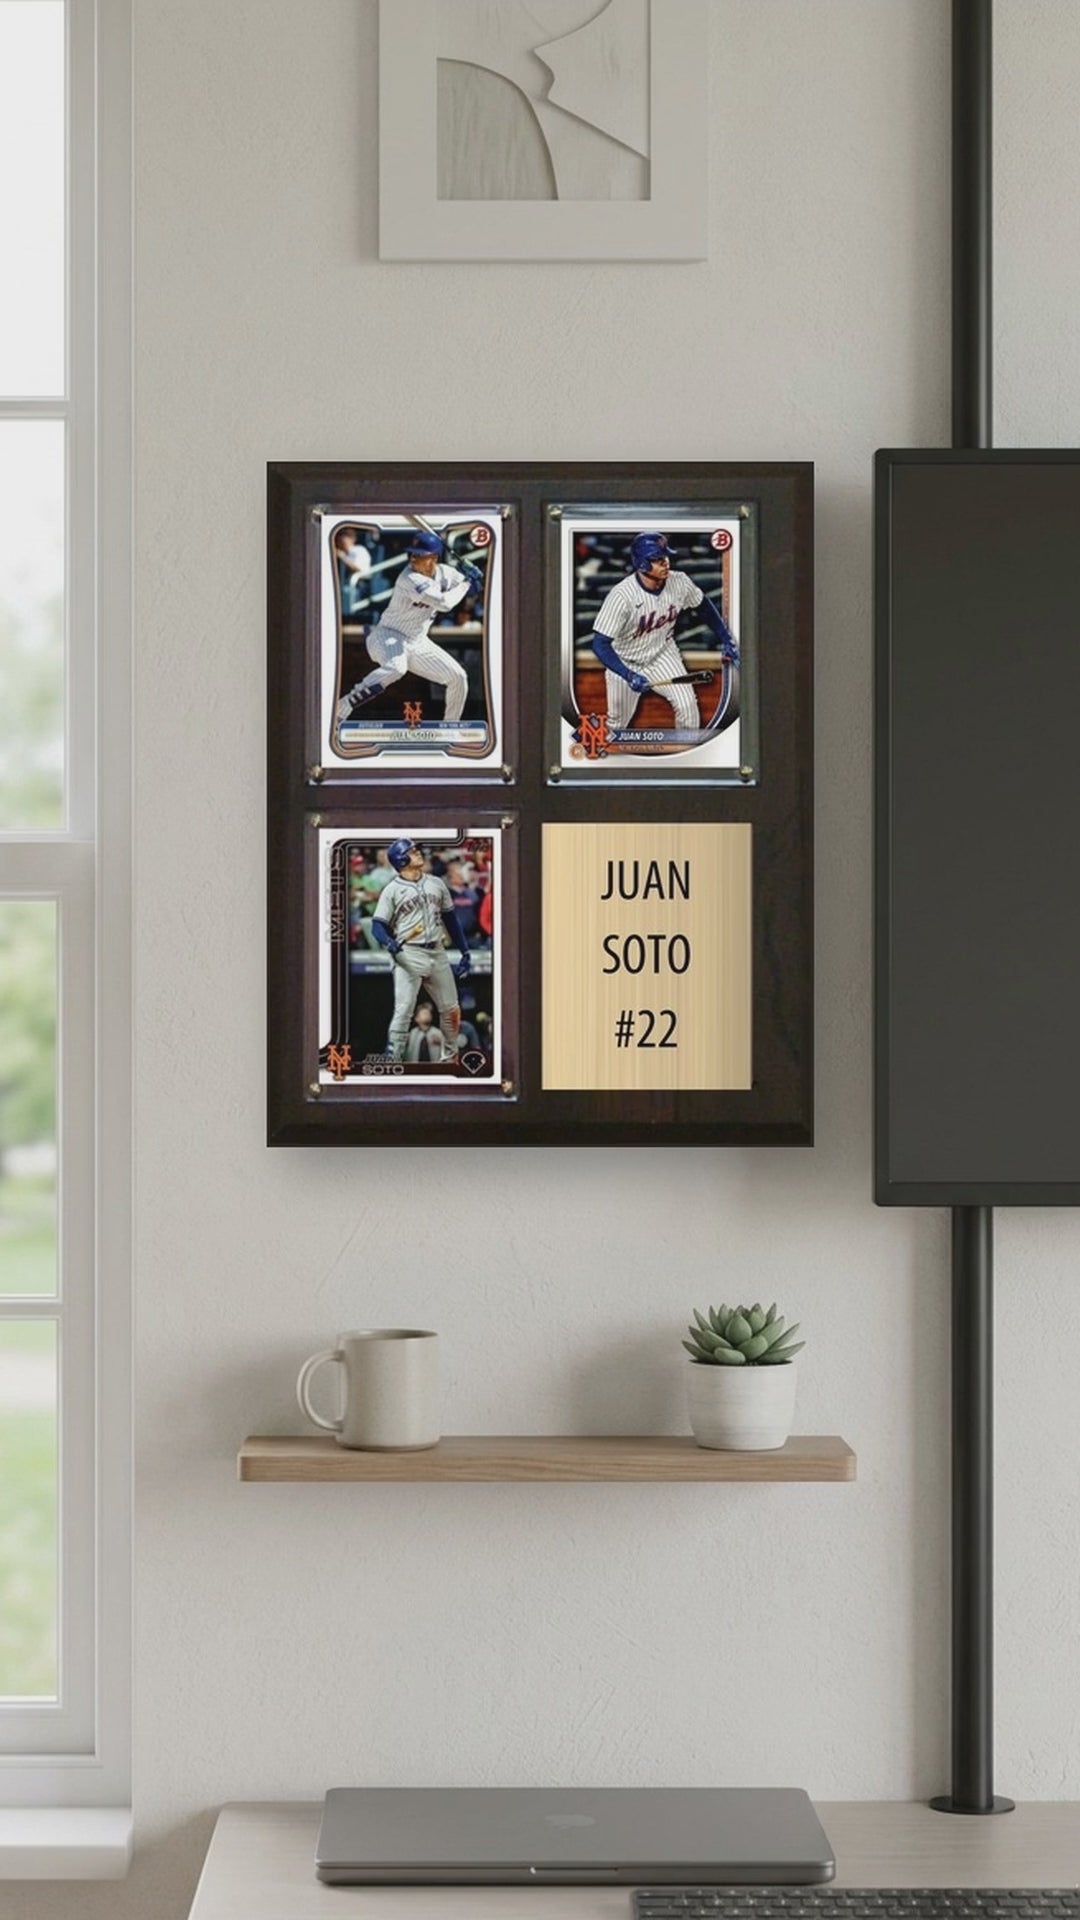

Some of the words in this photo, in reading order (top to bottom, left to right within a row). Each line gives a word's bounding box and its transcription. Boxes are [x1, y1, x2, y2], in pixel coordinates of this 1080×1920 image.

[475, 529, 488, 543] B
[715, 533, 728, 546] B
[618, 731, 642, 741] JUAN
[642, 731, 665, 741] SOTO
[601, 860, 690, 900] JUAN
[325, 847, 345, 942] METS
[602, 934, 691, 974] SOTO
[615, 1010, 678, 1048] #22
[362, 1064, 404, 1076] SOTO
